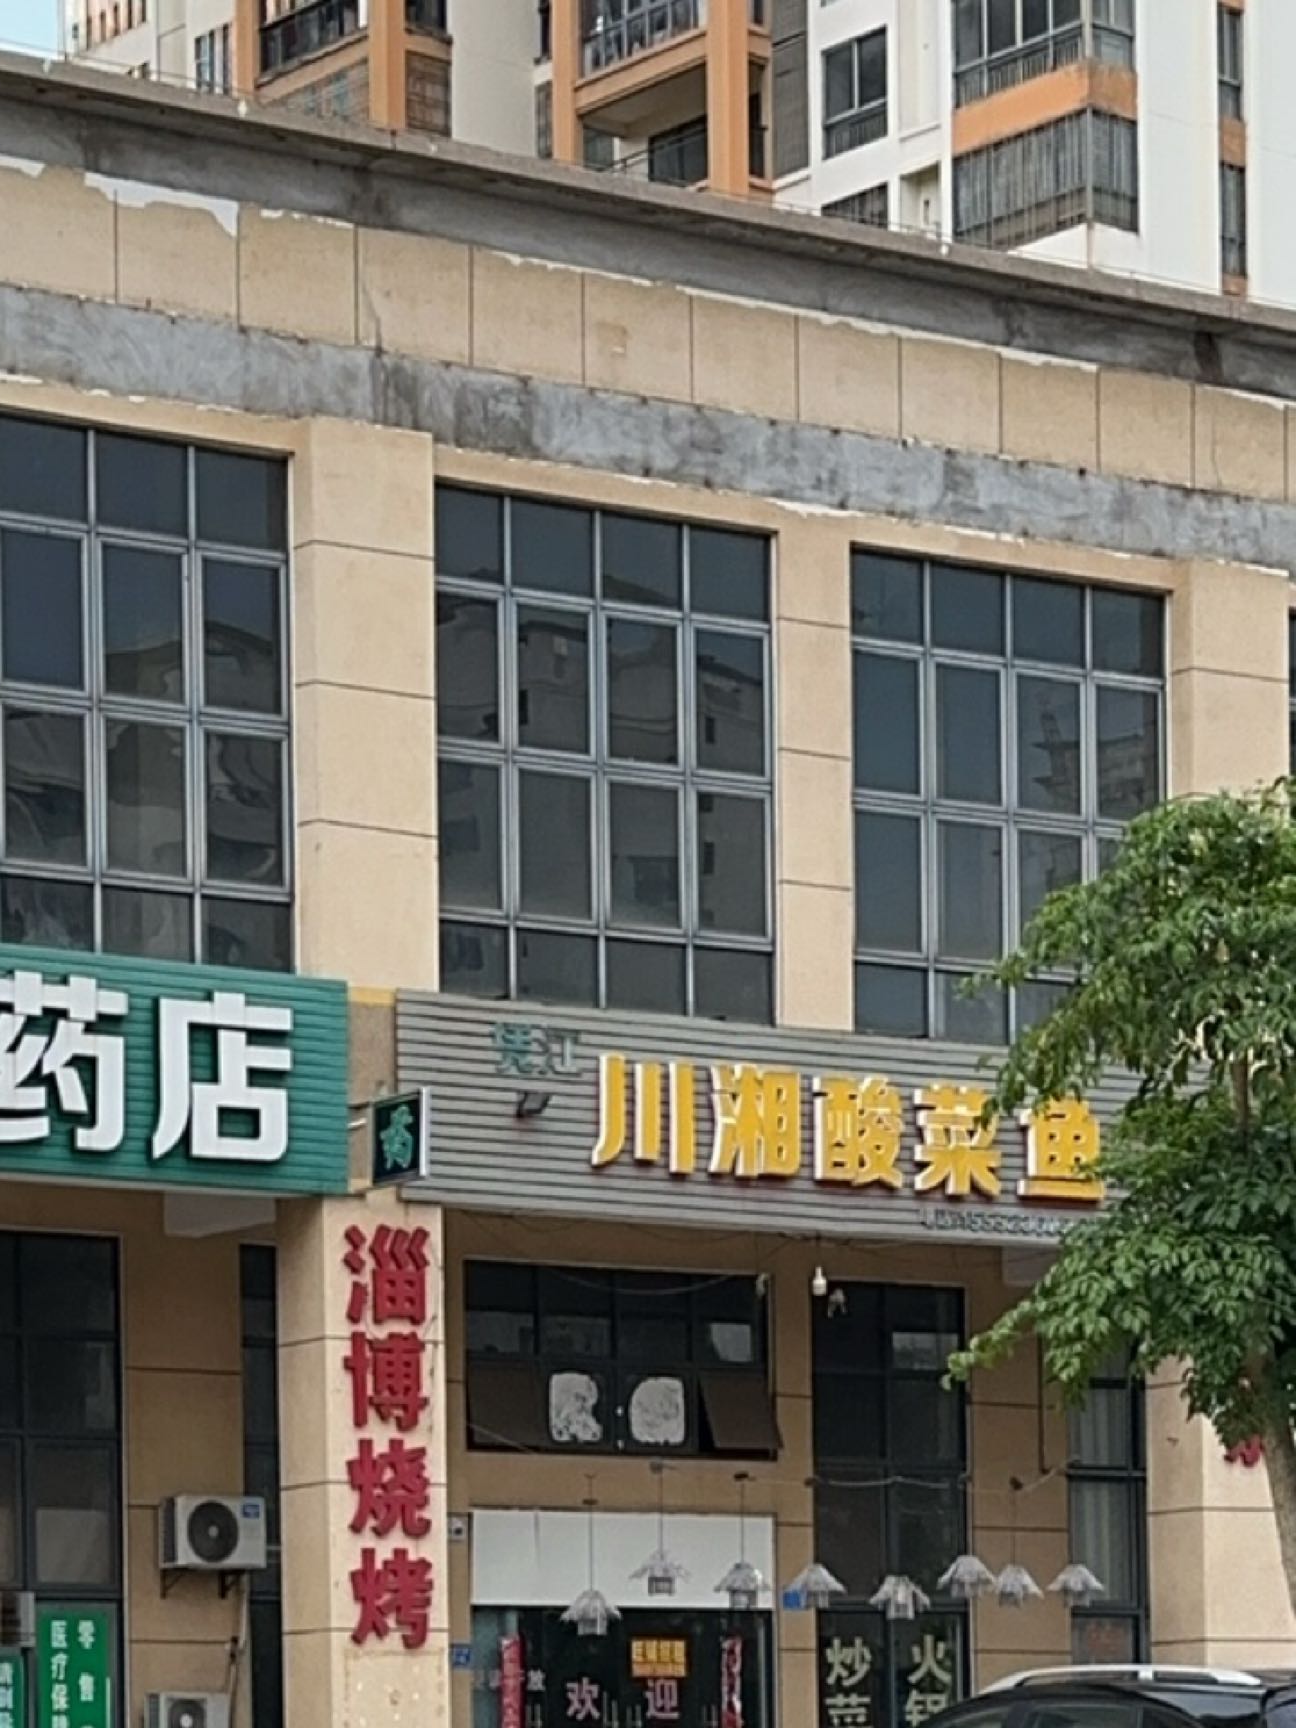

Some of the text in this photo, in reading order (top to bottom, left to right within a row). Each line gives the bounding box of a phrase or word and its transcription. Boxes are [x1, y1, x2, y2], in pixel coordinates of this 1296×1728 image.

[591, 1054, 1106, 1200] 川湘酸菜鱼
[343, 1224, 435, 1650] 淄博烧烤
